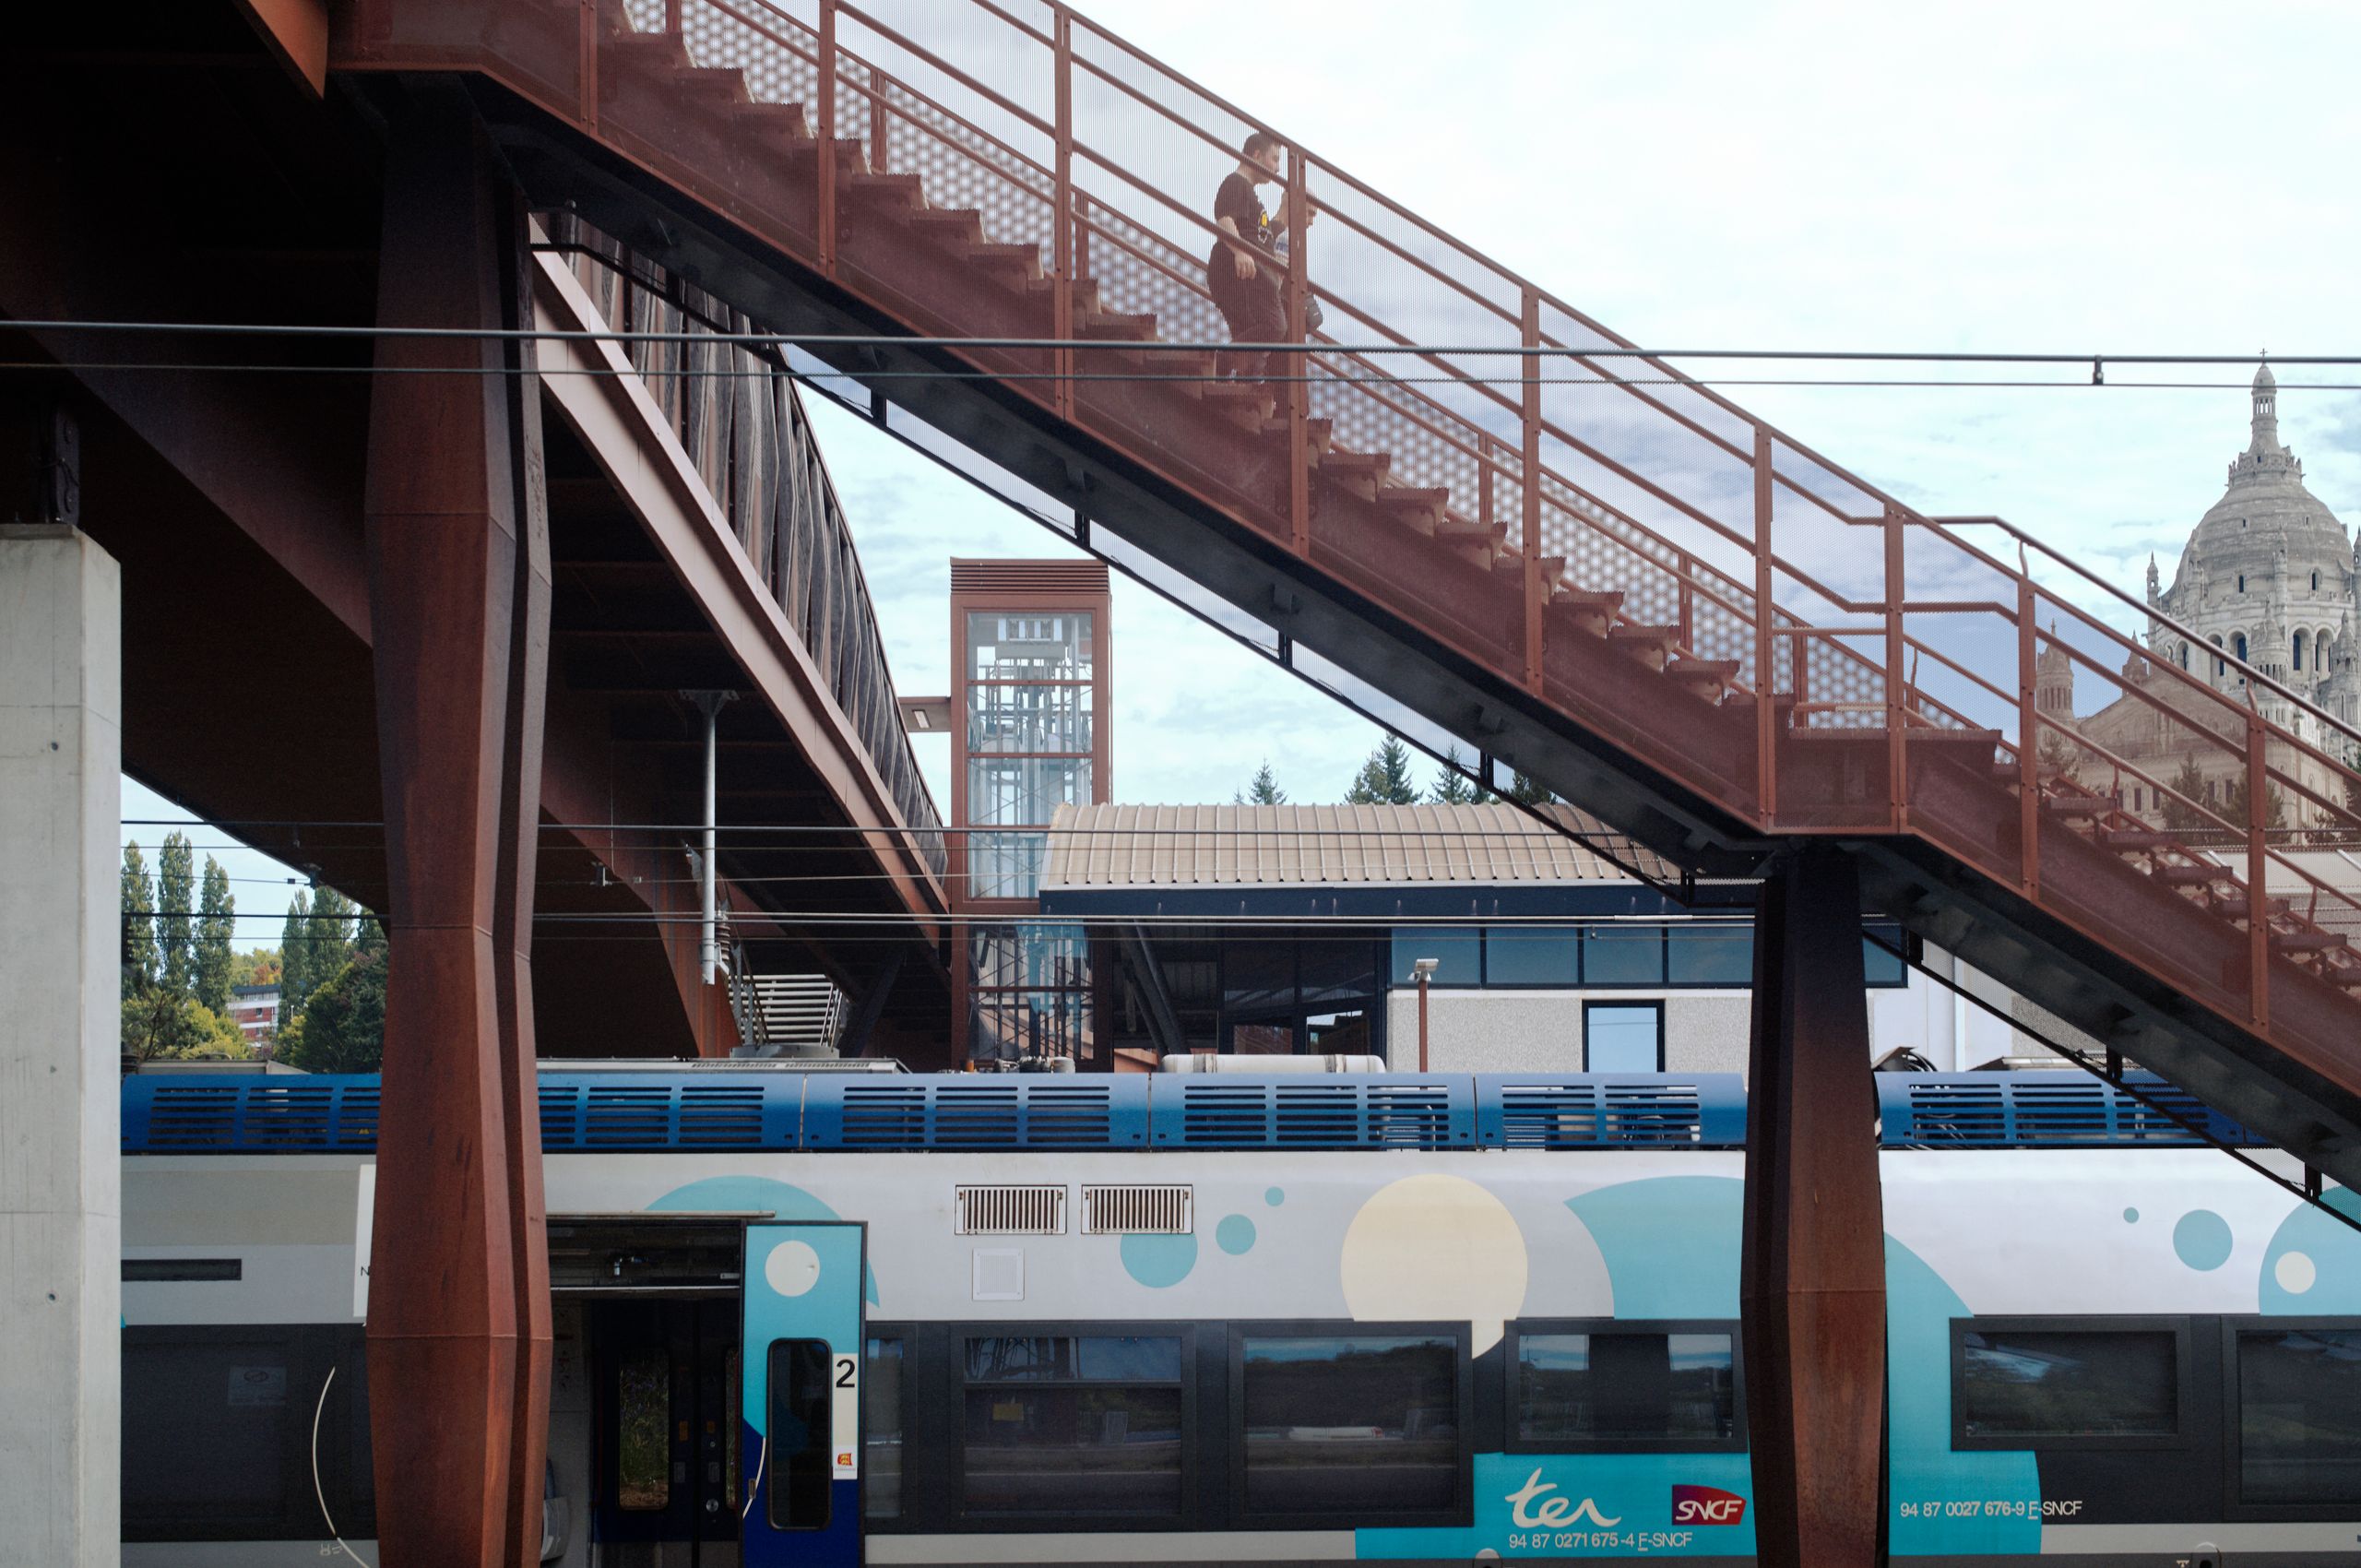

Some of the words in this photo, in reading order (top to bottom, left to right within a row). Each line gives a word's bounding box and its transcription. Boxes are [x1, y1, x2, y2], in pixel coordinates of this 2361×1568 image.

[836, 1359, 856, 1388] 2
[1504, 1467, 1622, 1528] ter
[1900, 1502, 1919, 1516] 94
[1923, 1502, 1941, 1516] 87
[1945, 1501, 1981, 1516] 0027
[1984, 1501, 2025, 1516] 676-9
[1675, 1500, 1742, 1522] SNCF
[1509, 1534, 1528, 1549] 94
[1532, 1533, 1550, 1549] 87
[1554, 1533, 1588, 1548] 0271
